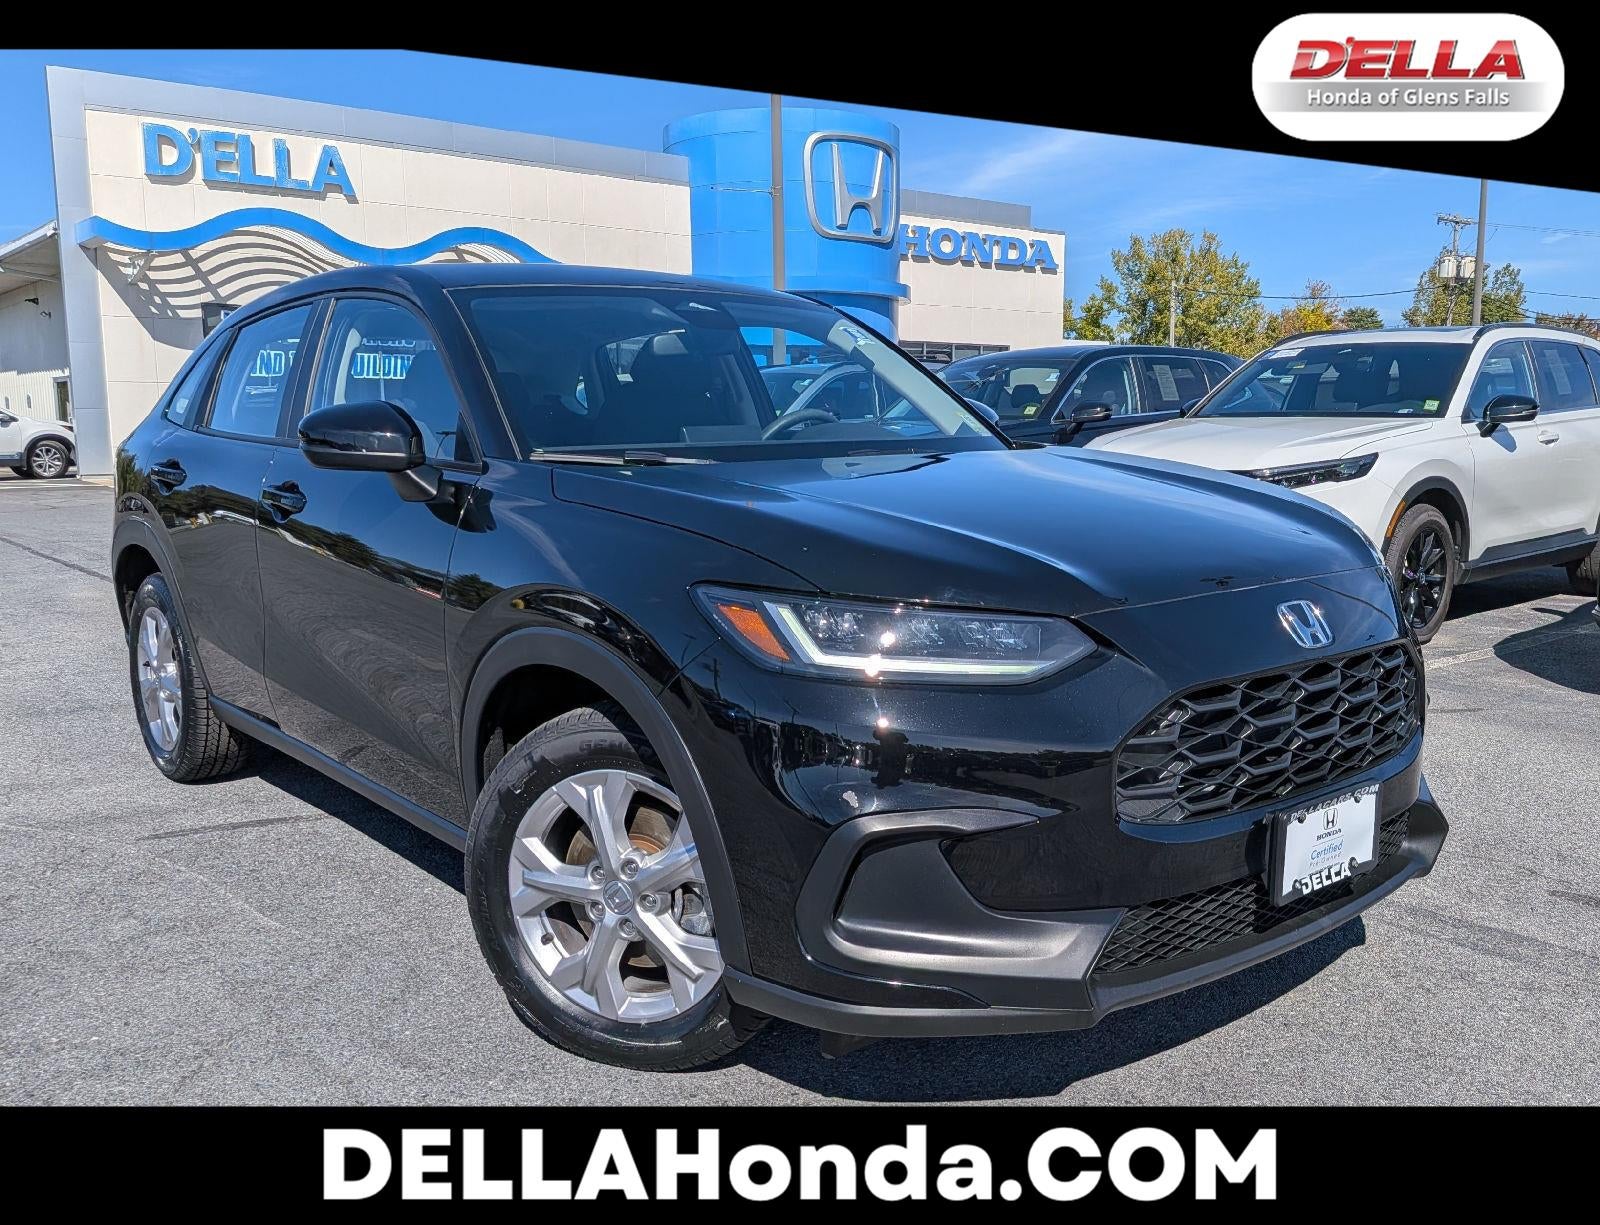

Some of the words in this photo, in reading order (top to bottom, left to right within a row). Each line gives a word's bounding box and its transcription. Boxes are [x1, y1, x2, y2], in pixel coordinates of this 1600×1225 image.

[142, 121, 358, 198] D'ELLA
[899, 223, 1059, 271] HONDA
[1310, 838, 1344, 860] Certified
[1316, 828, 1342, 841] HONDA
